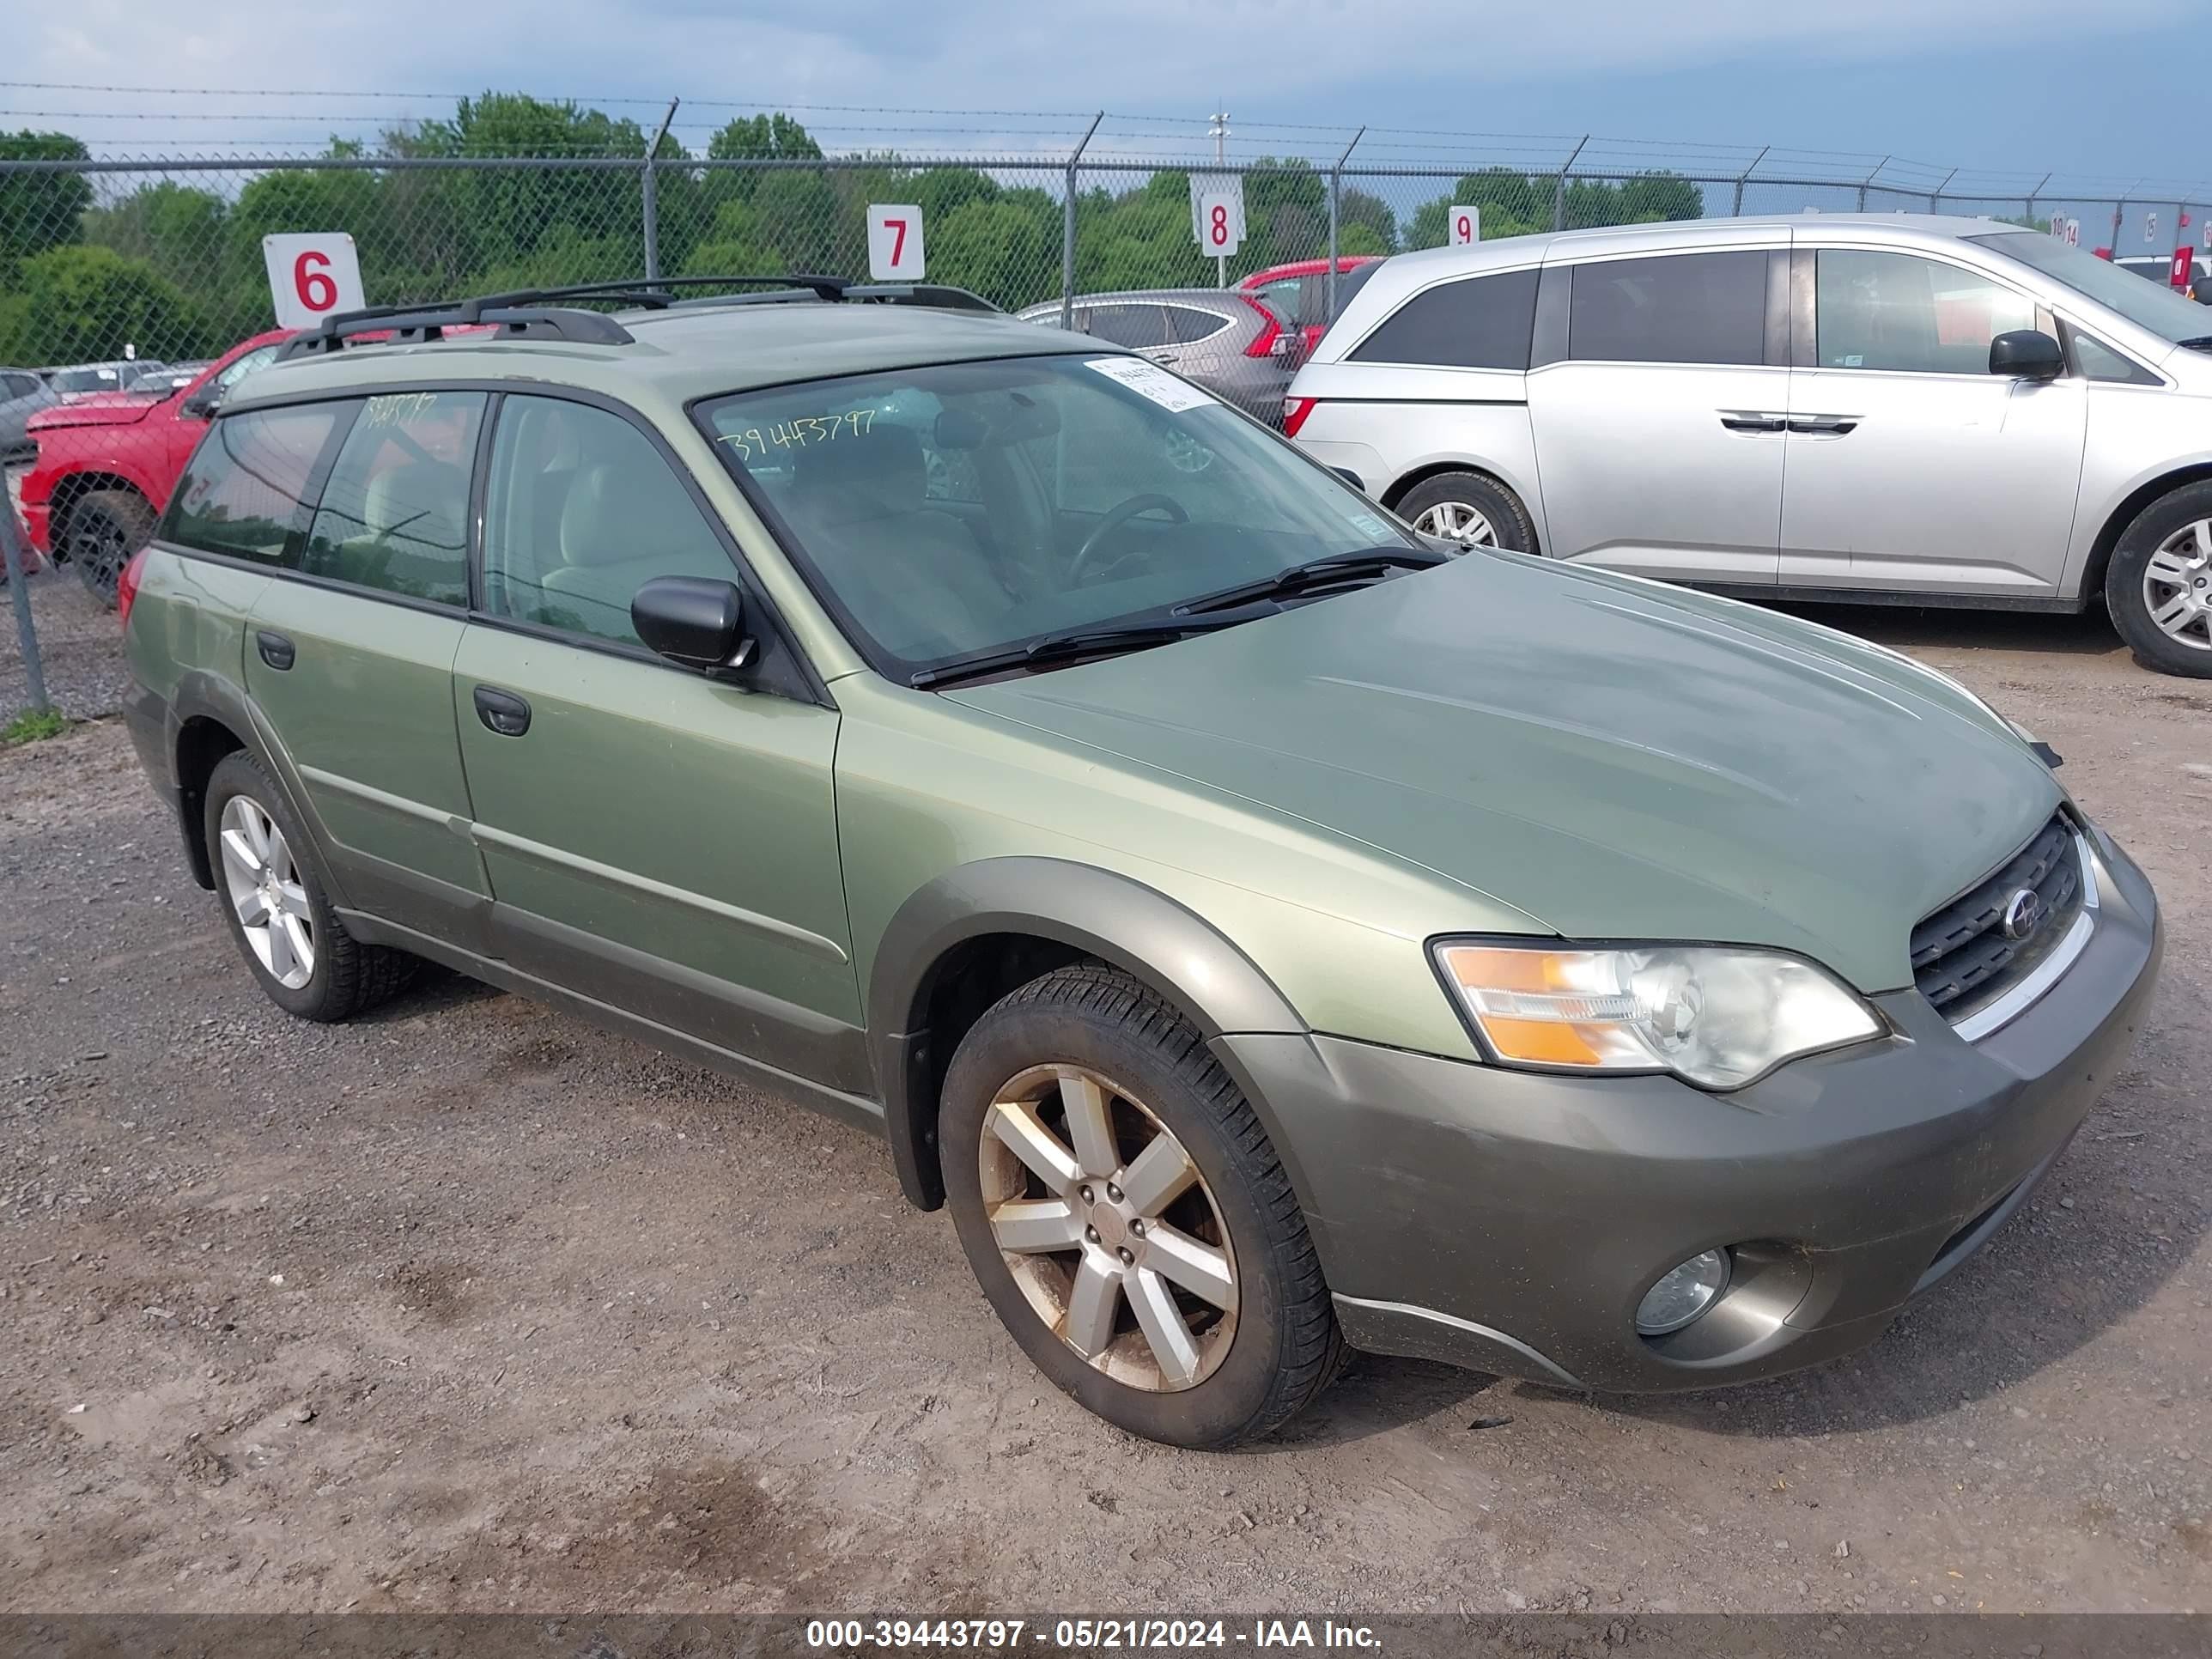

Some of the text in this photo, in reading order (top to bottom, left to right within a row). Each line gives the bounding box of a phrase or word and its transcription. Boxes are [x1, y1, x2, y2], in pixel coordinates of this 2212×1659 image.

[884, 220, 906, 267] 7
[1212, 205, 1227, 246] 8
[1457, 216, 1471, 244] 9
[2067, 225, 2076, 246] 14
[295, 252, 337, 312] 6
[717, 410, 875, 461] 39443797
